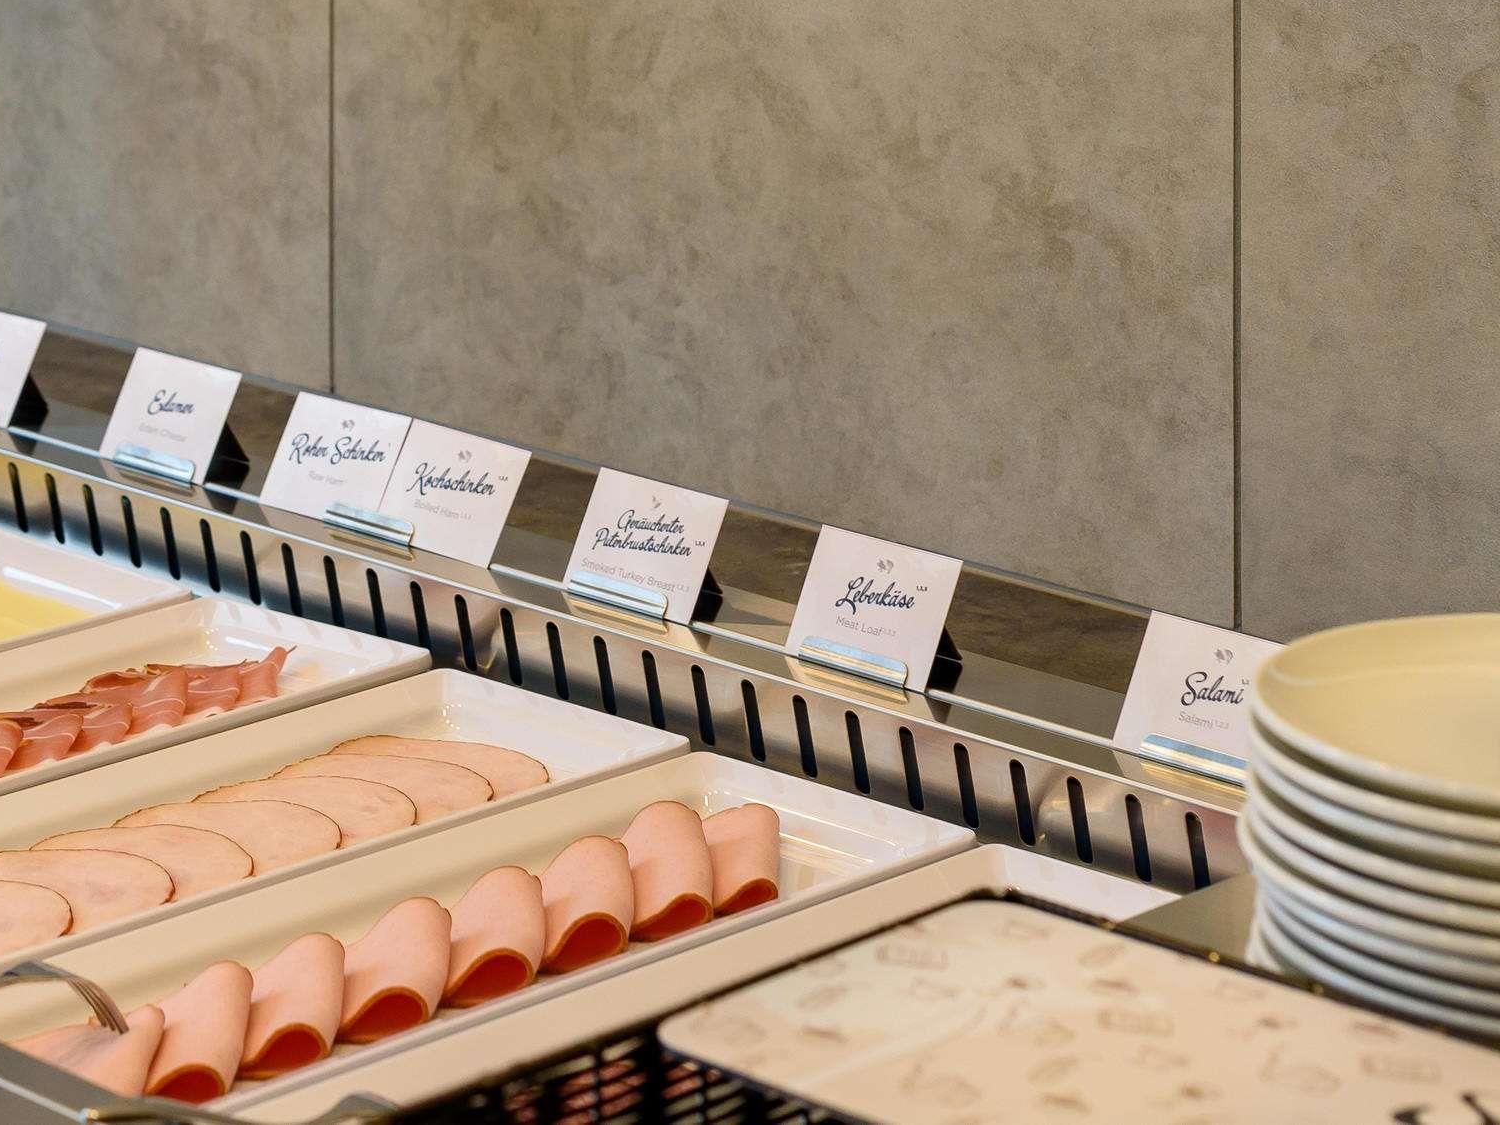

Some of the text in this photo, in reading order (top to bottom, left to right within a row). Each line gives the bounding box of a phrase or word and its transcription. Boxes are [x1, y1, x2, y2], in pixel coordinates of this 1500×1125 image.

[147, 389, 195, 415] Edamer
[288, 433, 386, 465] Roher Schinken
[406, 462, 496, 496] Kochschinken
[617, 509, 685, 534] Geräucherter
[592, 527, 693, 557] Putenbrustschinken
[581, 557, 616, 575] Smoked
[618, 568, 645, 585] Turkey
[646, 576, 676, 593] Breast
[835, 576, 916, 615] Leberkäse
[836, 615, 859, 631] Meat
[861, 623, 883, 636] Loaf
[1180, 671, 1244, 706] Salami
